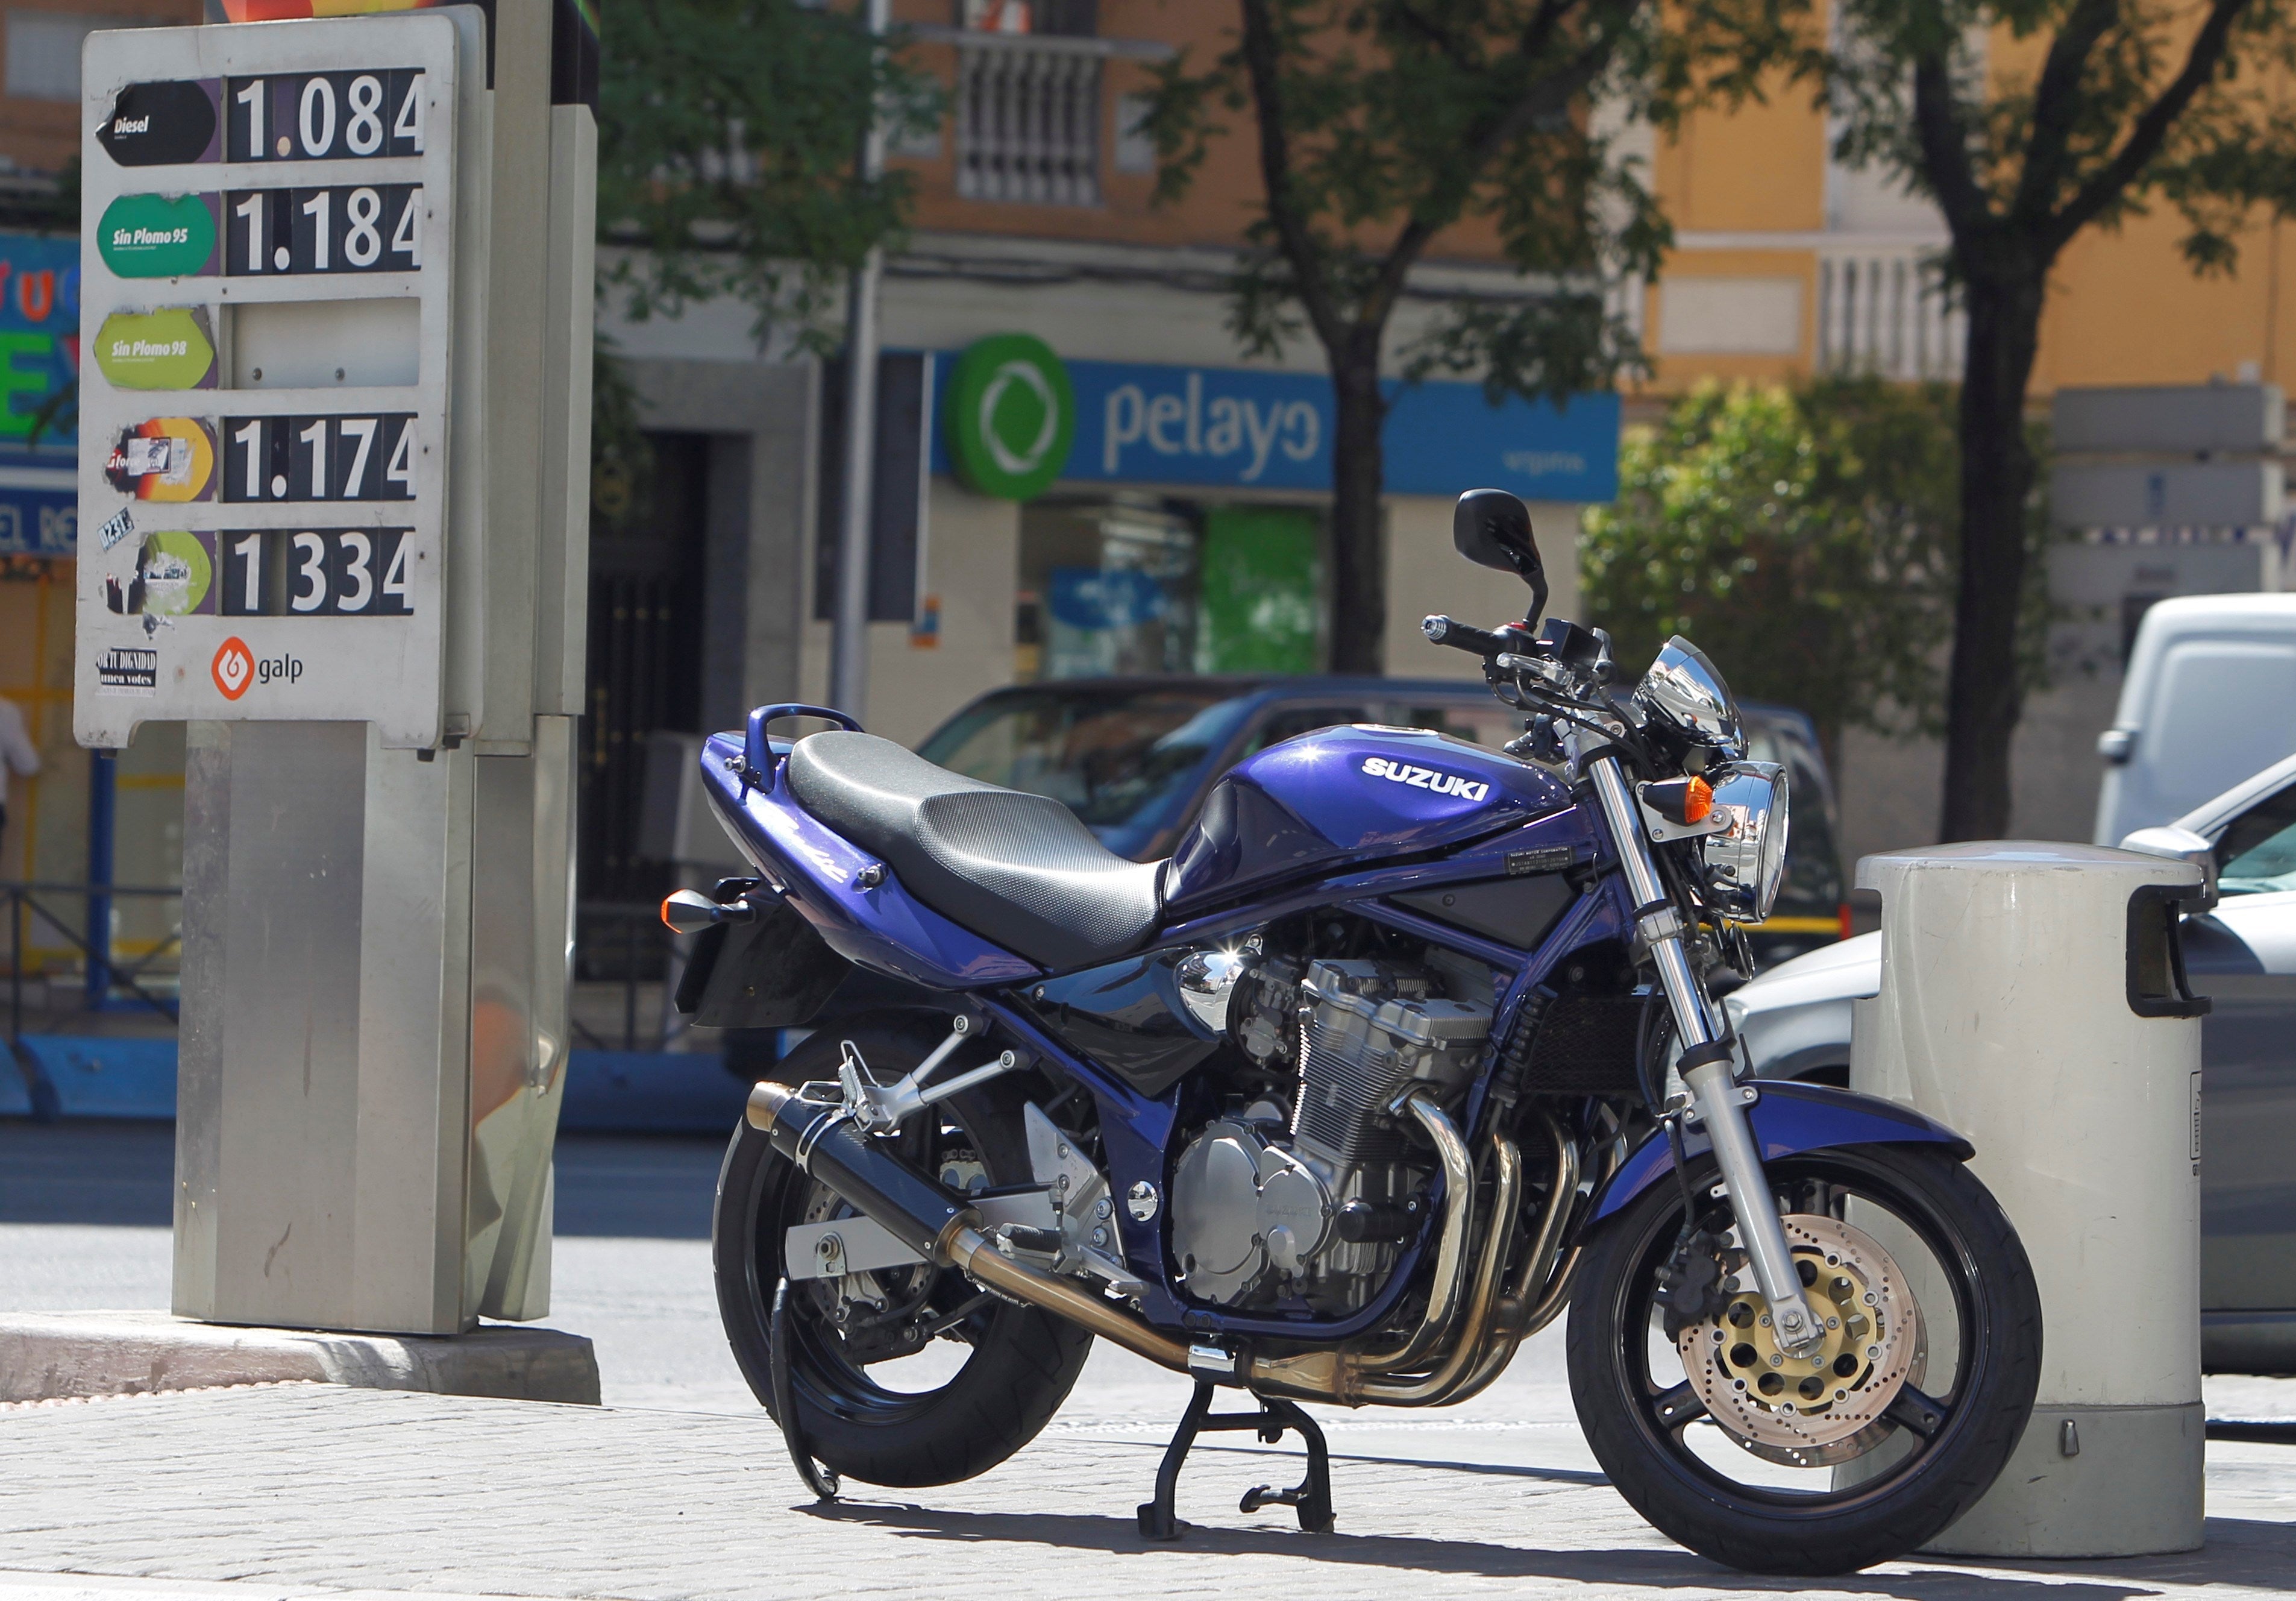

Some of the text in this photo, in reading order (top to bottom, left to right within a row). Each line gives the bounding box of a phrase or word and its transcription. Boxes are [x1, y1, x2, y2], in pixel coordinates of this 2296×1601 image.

[114, 115, 149, 134] Diesel
[237, 74, 425, 157] 1.084
[113, 227, 188, 245] Sin Plomo 95
[236, 187, 422, 271] 1.184
[111, 339, 187, 356] Sin Plomo 98
[1103, 372, 1320, 481] pelayo
[235, 417, 419, 497] 1.174
[120, 651, 155, 670] DIGNIDAD
[259, 653, 303, 684] galp
[127, 673, 152, 685] votes
[1361, 757, 1490, 802] SUZUKI
